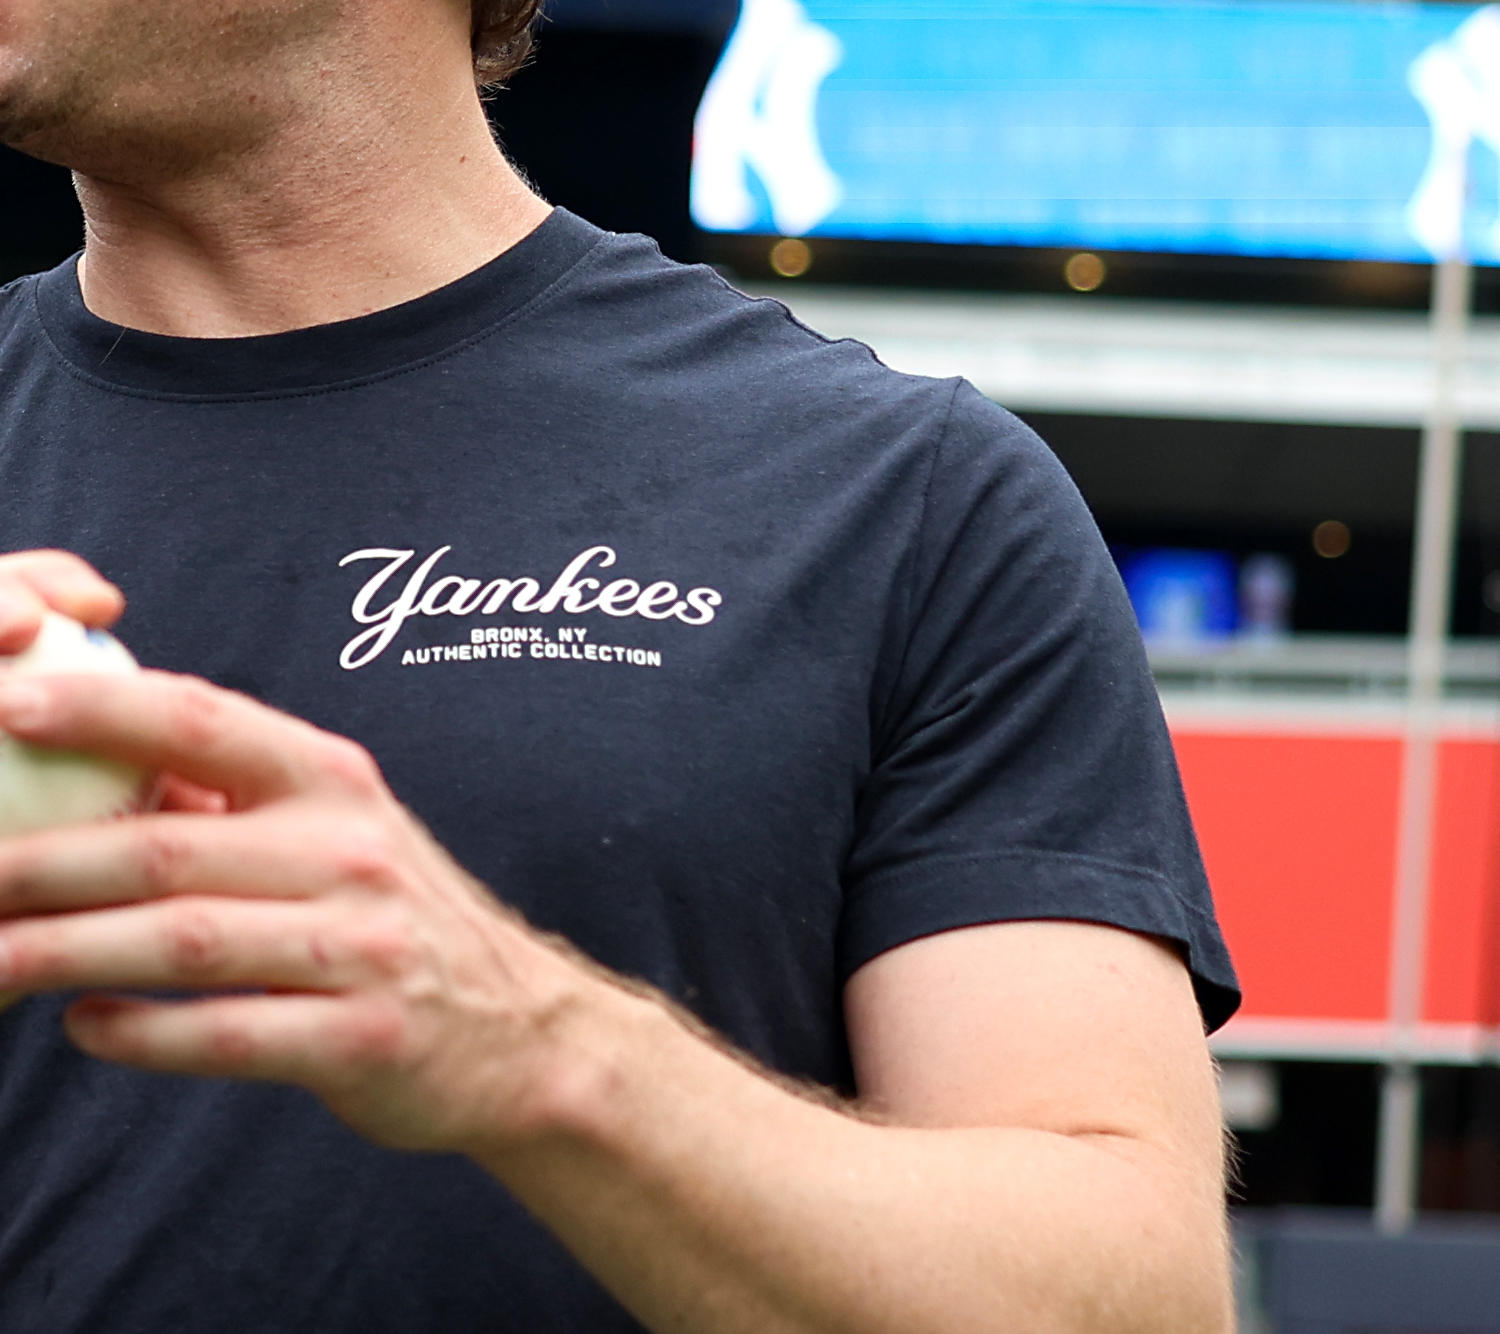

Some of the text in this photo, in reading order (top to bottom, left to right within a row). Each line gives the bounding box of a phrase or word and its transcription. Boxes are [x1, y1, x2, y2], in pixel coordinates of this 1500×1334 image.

[338, 545, 722, 670] Yankees
[558, 628, 587, 642] NY
[401, 643, 661, 667] AUTHENTIC COLLECTION
